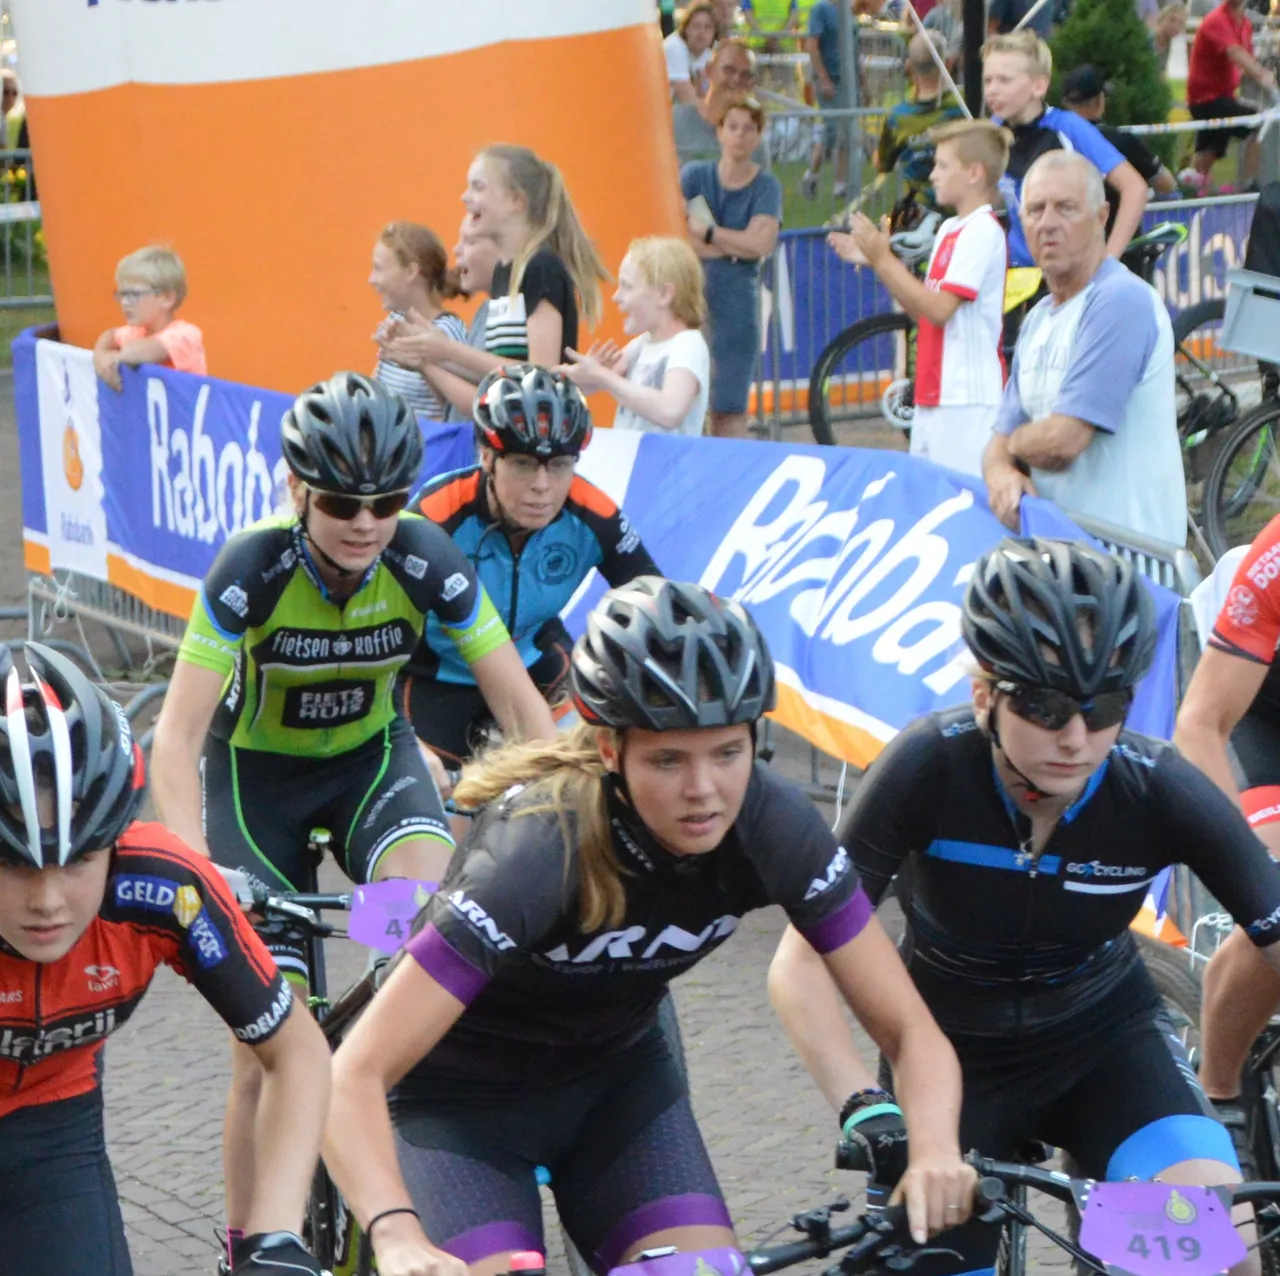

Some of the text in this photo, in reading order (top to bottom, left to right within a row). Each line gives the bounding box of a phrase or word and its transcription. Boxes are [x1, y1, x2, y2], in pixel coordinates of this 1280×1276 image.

[147, 377, 294, 545] Rabob
[59, 511, 94, 545] Rabobank
[272, 629, 329, 659] fietsen
[300, 686, 366, 704] FIETS
[298, 702, 364, 720] HUIS
[116, 880, 175, 907] GELD
[448, 890, 518, 951] ARNT
[1126, 1233, 1203, 1263] 419
